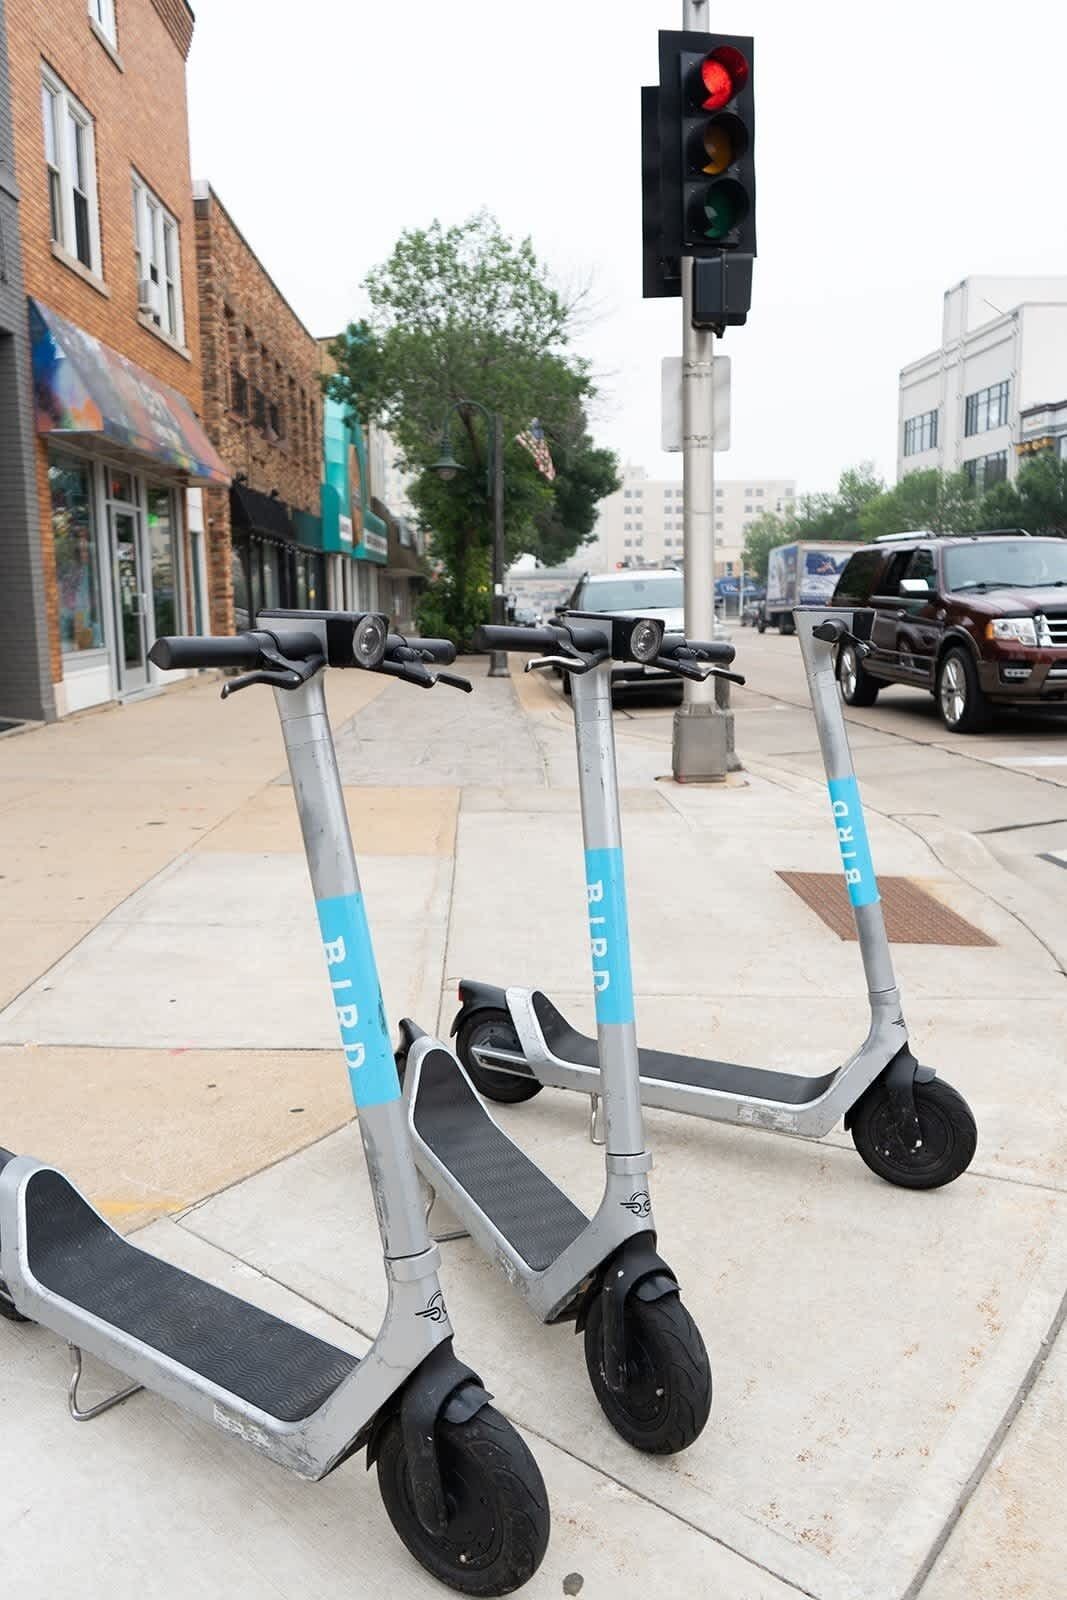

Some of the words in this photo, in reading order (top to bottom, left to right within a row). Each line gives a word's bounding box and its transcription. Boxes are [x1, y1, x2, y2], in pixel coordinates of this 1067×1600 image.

[832, 800, 862, 884] BIRD
[586, 879, 610, 992] BIRD
[323, 935, 366, 1069] BIRD
